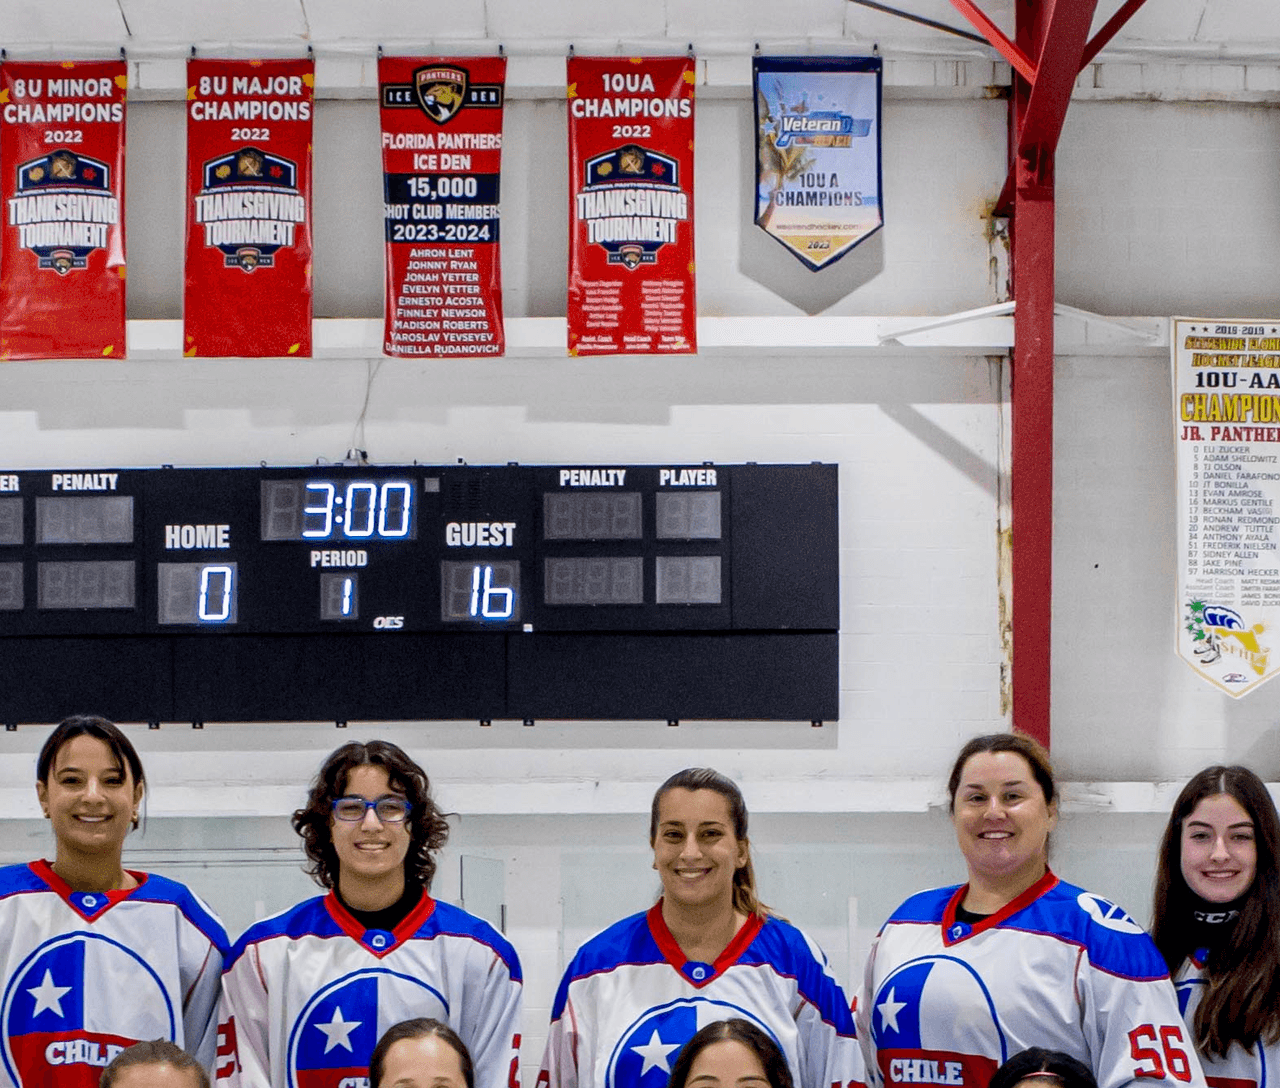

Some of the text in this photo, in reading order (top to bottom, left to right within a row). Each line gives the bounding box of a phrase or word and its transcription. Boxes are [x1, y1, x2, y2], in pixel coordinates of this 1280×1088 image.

[420, 70, 462, 82] PANTHERS
[602, 73, 655, 92] 10UA
[14, 78, 113, 98] 8U MINOR
[199, 76, 302, 96] 8U MAJOR
[389, 91, 496, 102] ICE DEN
[4, 103, 123, 124] CHAMPIONS
[191, 101, 311, 121] CHAMPIONS
[572, 98, 692, 118] CHAMPIONS
[612, 125, 651, 138] 2022
[783, 117, 841, 132] Veteran
[44, 130, 83, 143] 2022
[230, 127, 270, 141] 2022
[382, 132, 502, 149] FLORIDA PANTHERS
[413, 153, 471, 170] ICE DEN
[407, 177, 478, 200] 15,000
[799, 172, 839, 188] 10U A
[194, 191, 305, 222] THANKSGIVING
[577, 188, 688, 219] THANKSGIVING
[775, 191, 863, 206] CHAMPIONS
[8, 193, 119, 225] THANKSGIVING
[19, 222, 108, 248] TOURNAMENT
[205, 220, 295, 246] TOURNAMENT
[393, 224, 490, 241] 2023-2024
[587, 216, 678, 243] TOURNAMENT
[410, 249, 474, 257] AHRON LENT
[407, 261, 477, 270] JOHNNY RYAN
[405, 273, 479, 282] JONAH YETTER
[402, 284, 480, 293] EVELYN YETTER
[398, 296, 484, 305] ERNESTO ACOSTA
[397, 308, 486, 317] FINNLEY NEWSON
[394, 320, 489, 329] MADISON ROBERTS
[390, 331, 494, 341] YAROSLAV YEVSEYEV
[386, 342, 499, 354] DANIELLA RUDANOVICH
[1191, 352, 1241, 368] HOCKEY
[1181, 425, 1205, 441] JR.
[51, 473, 118, 491] PENALTY
[559, 469, 626, 487] PENALTY
[659, 469, 717, 487] PLAYER
[302, 482, 412, 538] 3:00
[165, 524, 230, 549] HOME
[445, 522, 516, 546] GUEST
[310, 551, 368, 567] PERIOD
[198, 566, 232, 621] 0
[341, 578, 353, 615] 1
[470, 565, 514, 618] 16
[373, 616, 404, 628] OES
[1128, 1024, 1193, 1083] 56
[888, 1057, 964, 1087] CHILE
